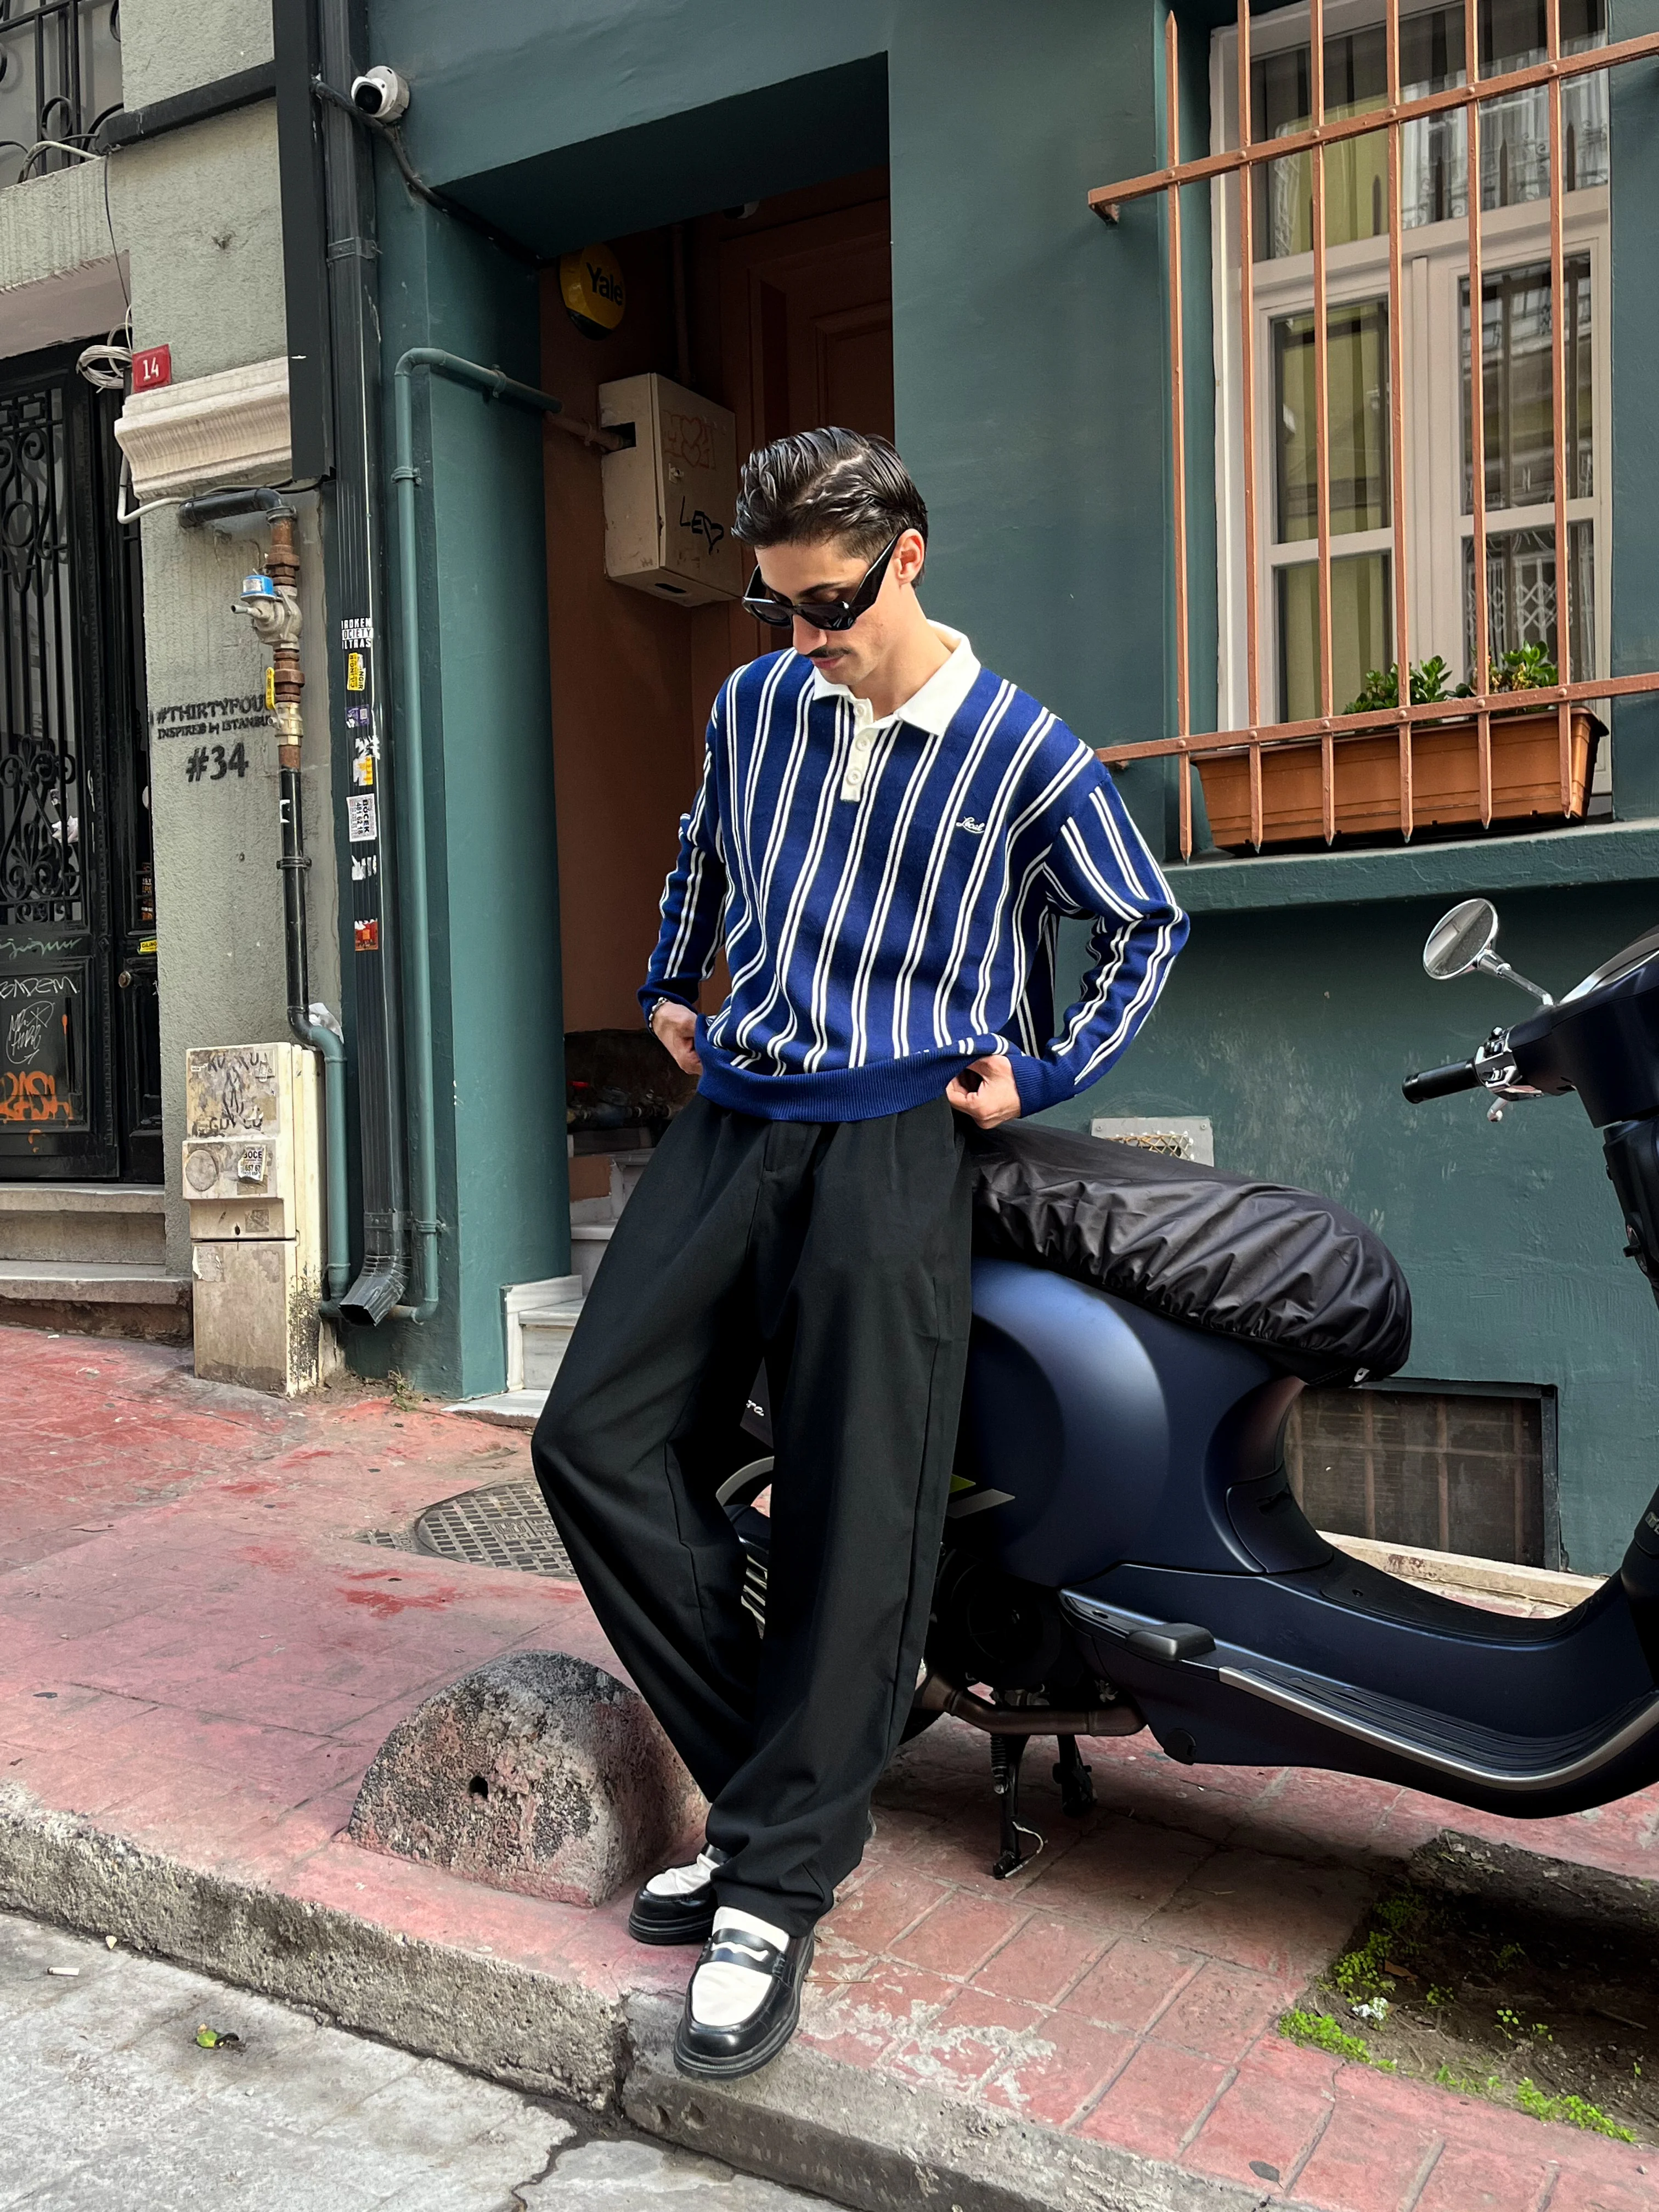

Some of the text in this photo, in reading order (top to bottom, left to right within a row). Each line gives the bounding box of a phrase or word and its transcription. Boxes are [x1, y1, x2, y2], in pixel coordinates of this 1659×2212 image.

[585, 262, 623, 306] Yale
[143, 357, 159, 381] 14
[343, 628, 371, 639] OCIETY
[157, 693, 266, 724] #THIRTYFOU
[222, 715, 271, 731] ISTANBU
[185, 742, 249, 783] #34
